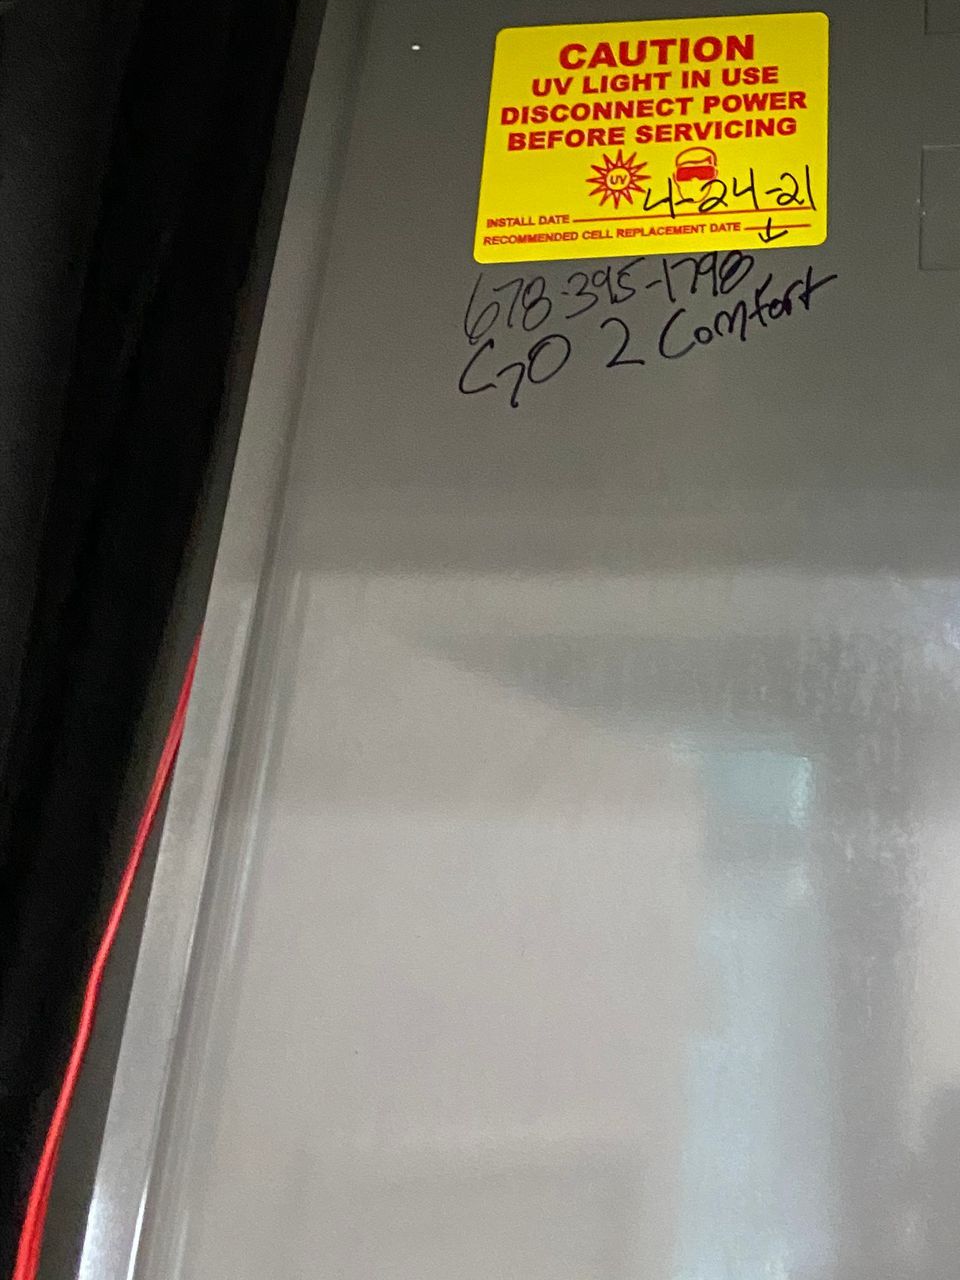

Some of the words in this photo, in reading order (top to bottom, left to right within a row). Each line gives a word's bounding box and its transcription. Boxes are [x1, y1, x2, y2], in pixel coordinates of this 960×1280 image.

[559, 34, 755, 70] CAUTION
[531, 77, 573, 97] UV
[582, 72, 672, 94] LIGHT
[682, 69, 711, 88] IN
[722, 66, 779, 86] USE
[500, 97, 694, 126] DISCONNECT
[703, 91, 807, 114] POWER
[507, 124, 625, 151] BEFORE
[635, 117, 797, 144] SERVICING
[609, 173, 627, 185] UV
[483, 228, 579, 246] RECOMMENDED
[582, 227, 614, 240] CELL
[616, 223, 706, 239] REPLACEMENT
[710, 222, 741, 233] DATE
[486, 216, 535, 228] INSTALL
[538, 215, 570, 225] DATE
[601, 317, 645, 368] 2
